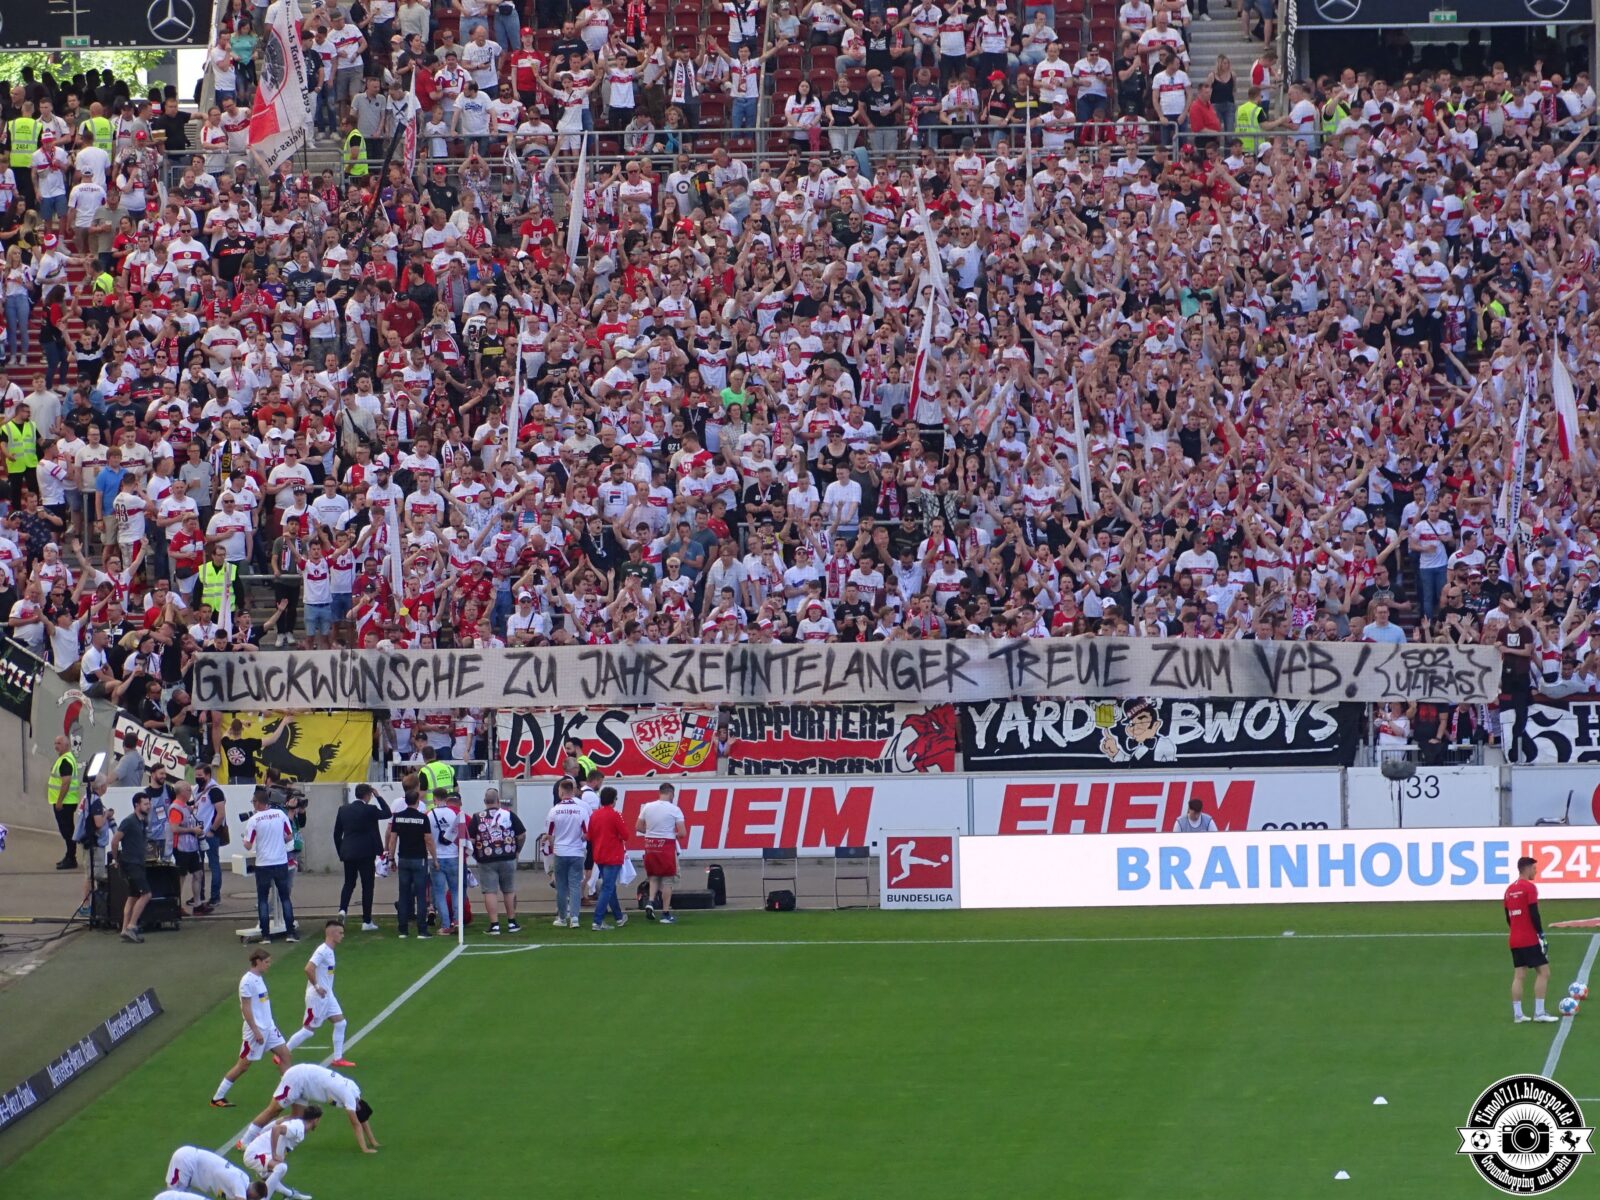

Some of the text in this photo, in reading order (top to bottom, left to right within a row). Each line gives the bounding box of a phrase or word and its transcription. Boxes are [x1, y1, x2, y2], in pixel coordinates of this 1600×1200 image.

[502, 651, 557, 698] ZU
[579, 642, 979, 699] JAHRZEHNTELANGER
[988, 640, 1130, 690] TREUE
[1150, 642, 1233, 693] ZUM
[1396, 668, 1476, 698] ULTRAS
[505, 710, 630, 769] DKS
[727, 703, 895, 742] SUPPORTERS
[967, 700, 1096, 749] YARD
[1168, 697, 1340, 745] BWOYS
[1406, 775, 1440, 799] 33
[1116, 841, 1510, 891] BRAINHOUSE
[886, 893, 954, 903] BUNDESLIGA
